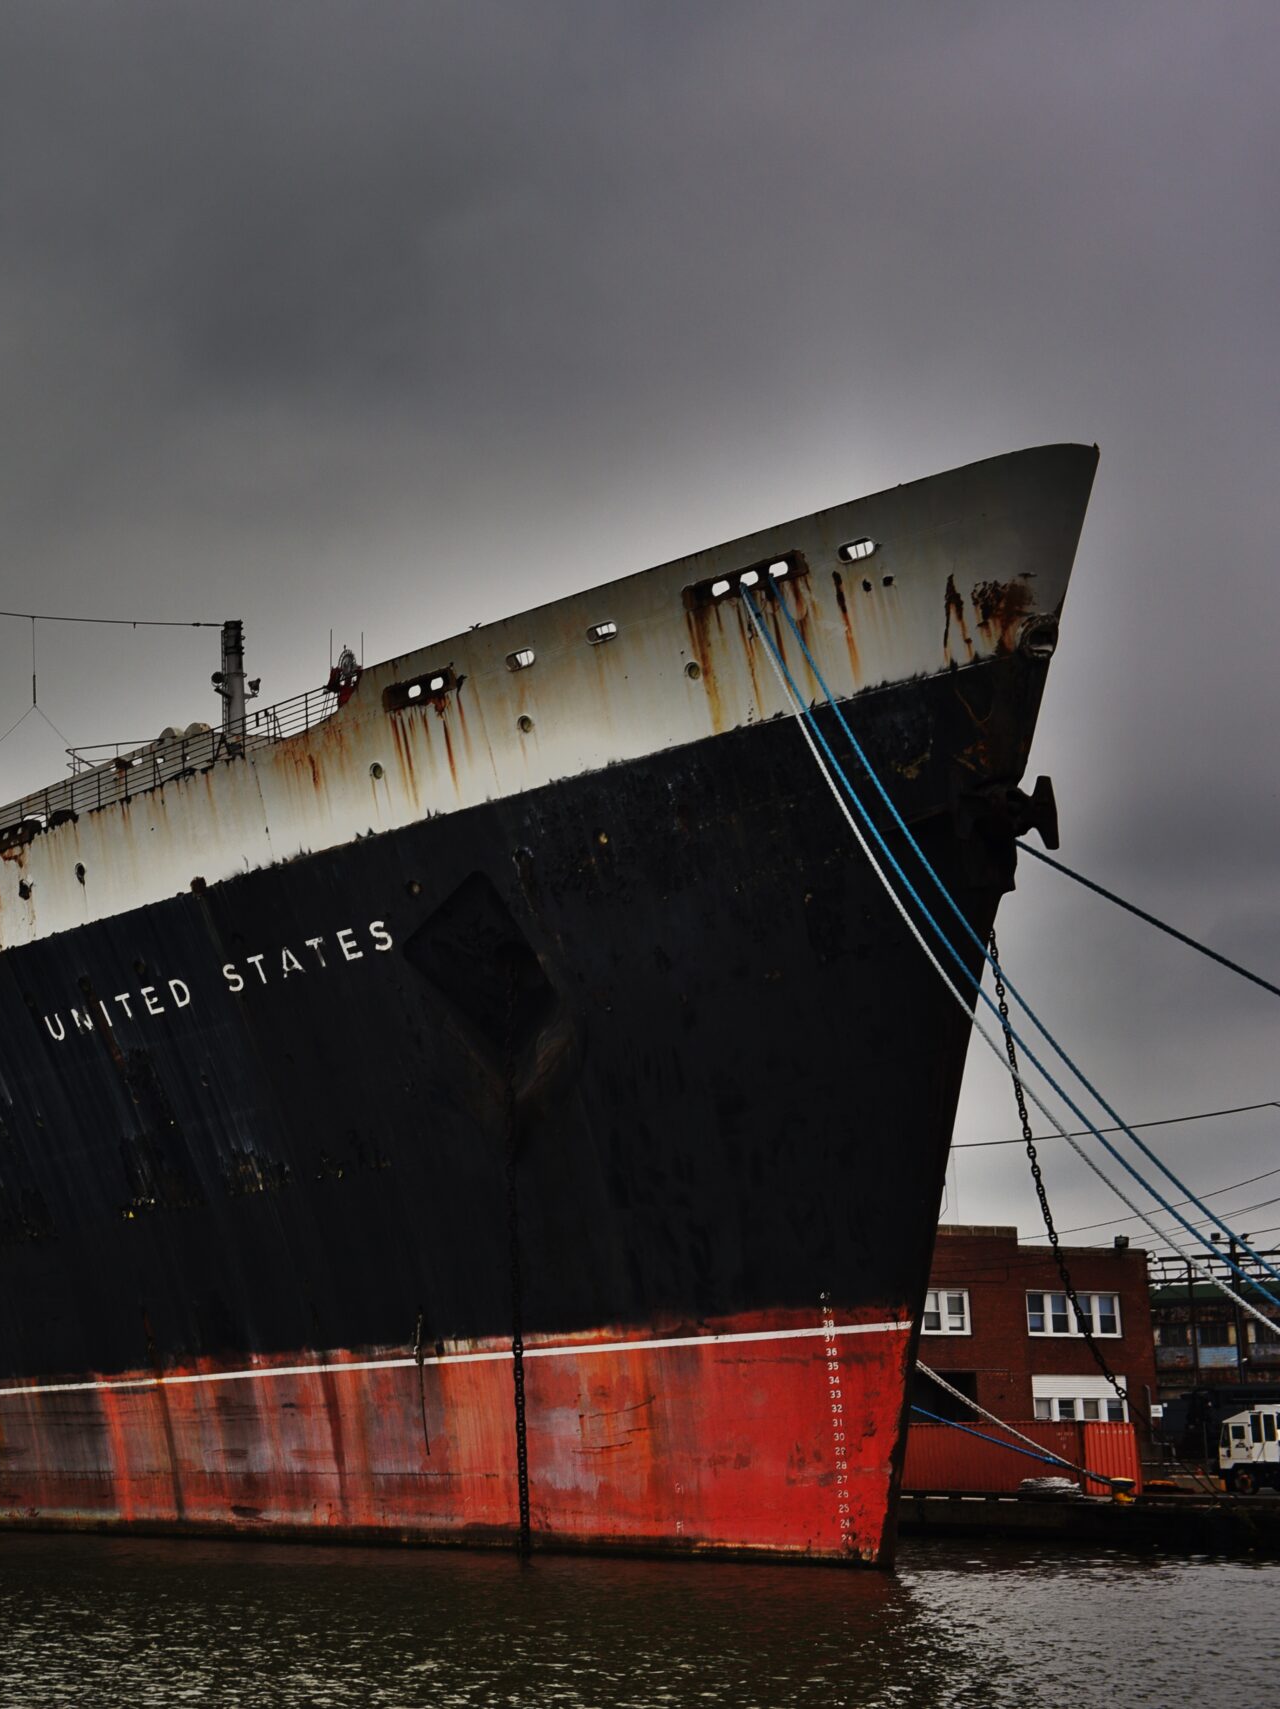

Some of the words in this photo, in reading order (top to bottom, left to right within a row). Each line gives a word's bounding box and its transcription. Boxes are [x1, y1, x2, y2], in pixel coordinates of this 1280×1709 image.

[44, 979, 191, 1041] UNITED
[222, 920, 393, 992] STATES
[823, 1320, 834, 1328] 38
[826, 1348, 837, 1356] 36
[828, 1362, 839, 1370] 35
[829, 1376, 840, 1384] 34
[830, 1390, 841, 1398] 33
[832, 1404, 842, 1413] 32
[833, 1419, 842, 1427] 31
[834, 1433, 845, 1441] 30
[836, 1461, 847, 1469] 28
[837, 1475, 847, 1484] 27
[838, 1490, 849, 1498] 26
[839, 1504, 849, 1513] 25
[840, 1519, 850, 1528] 24
